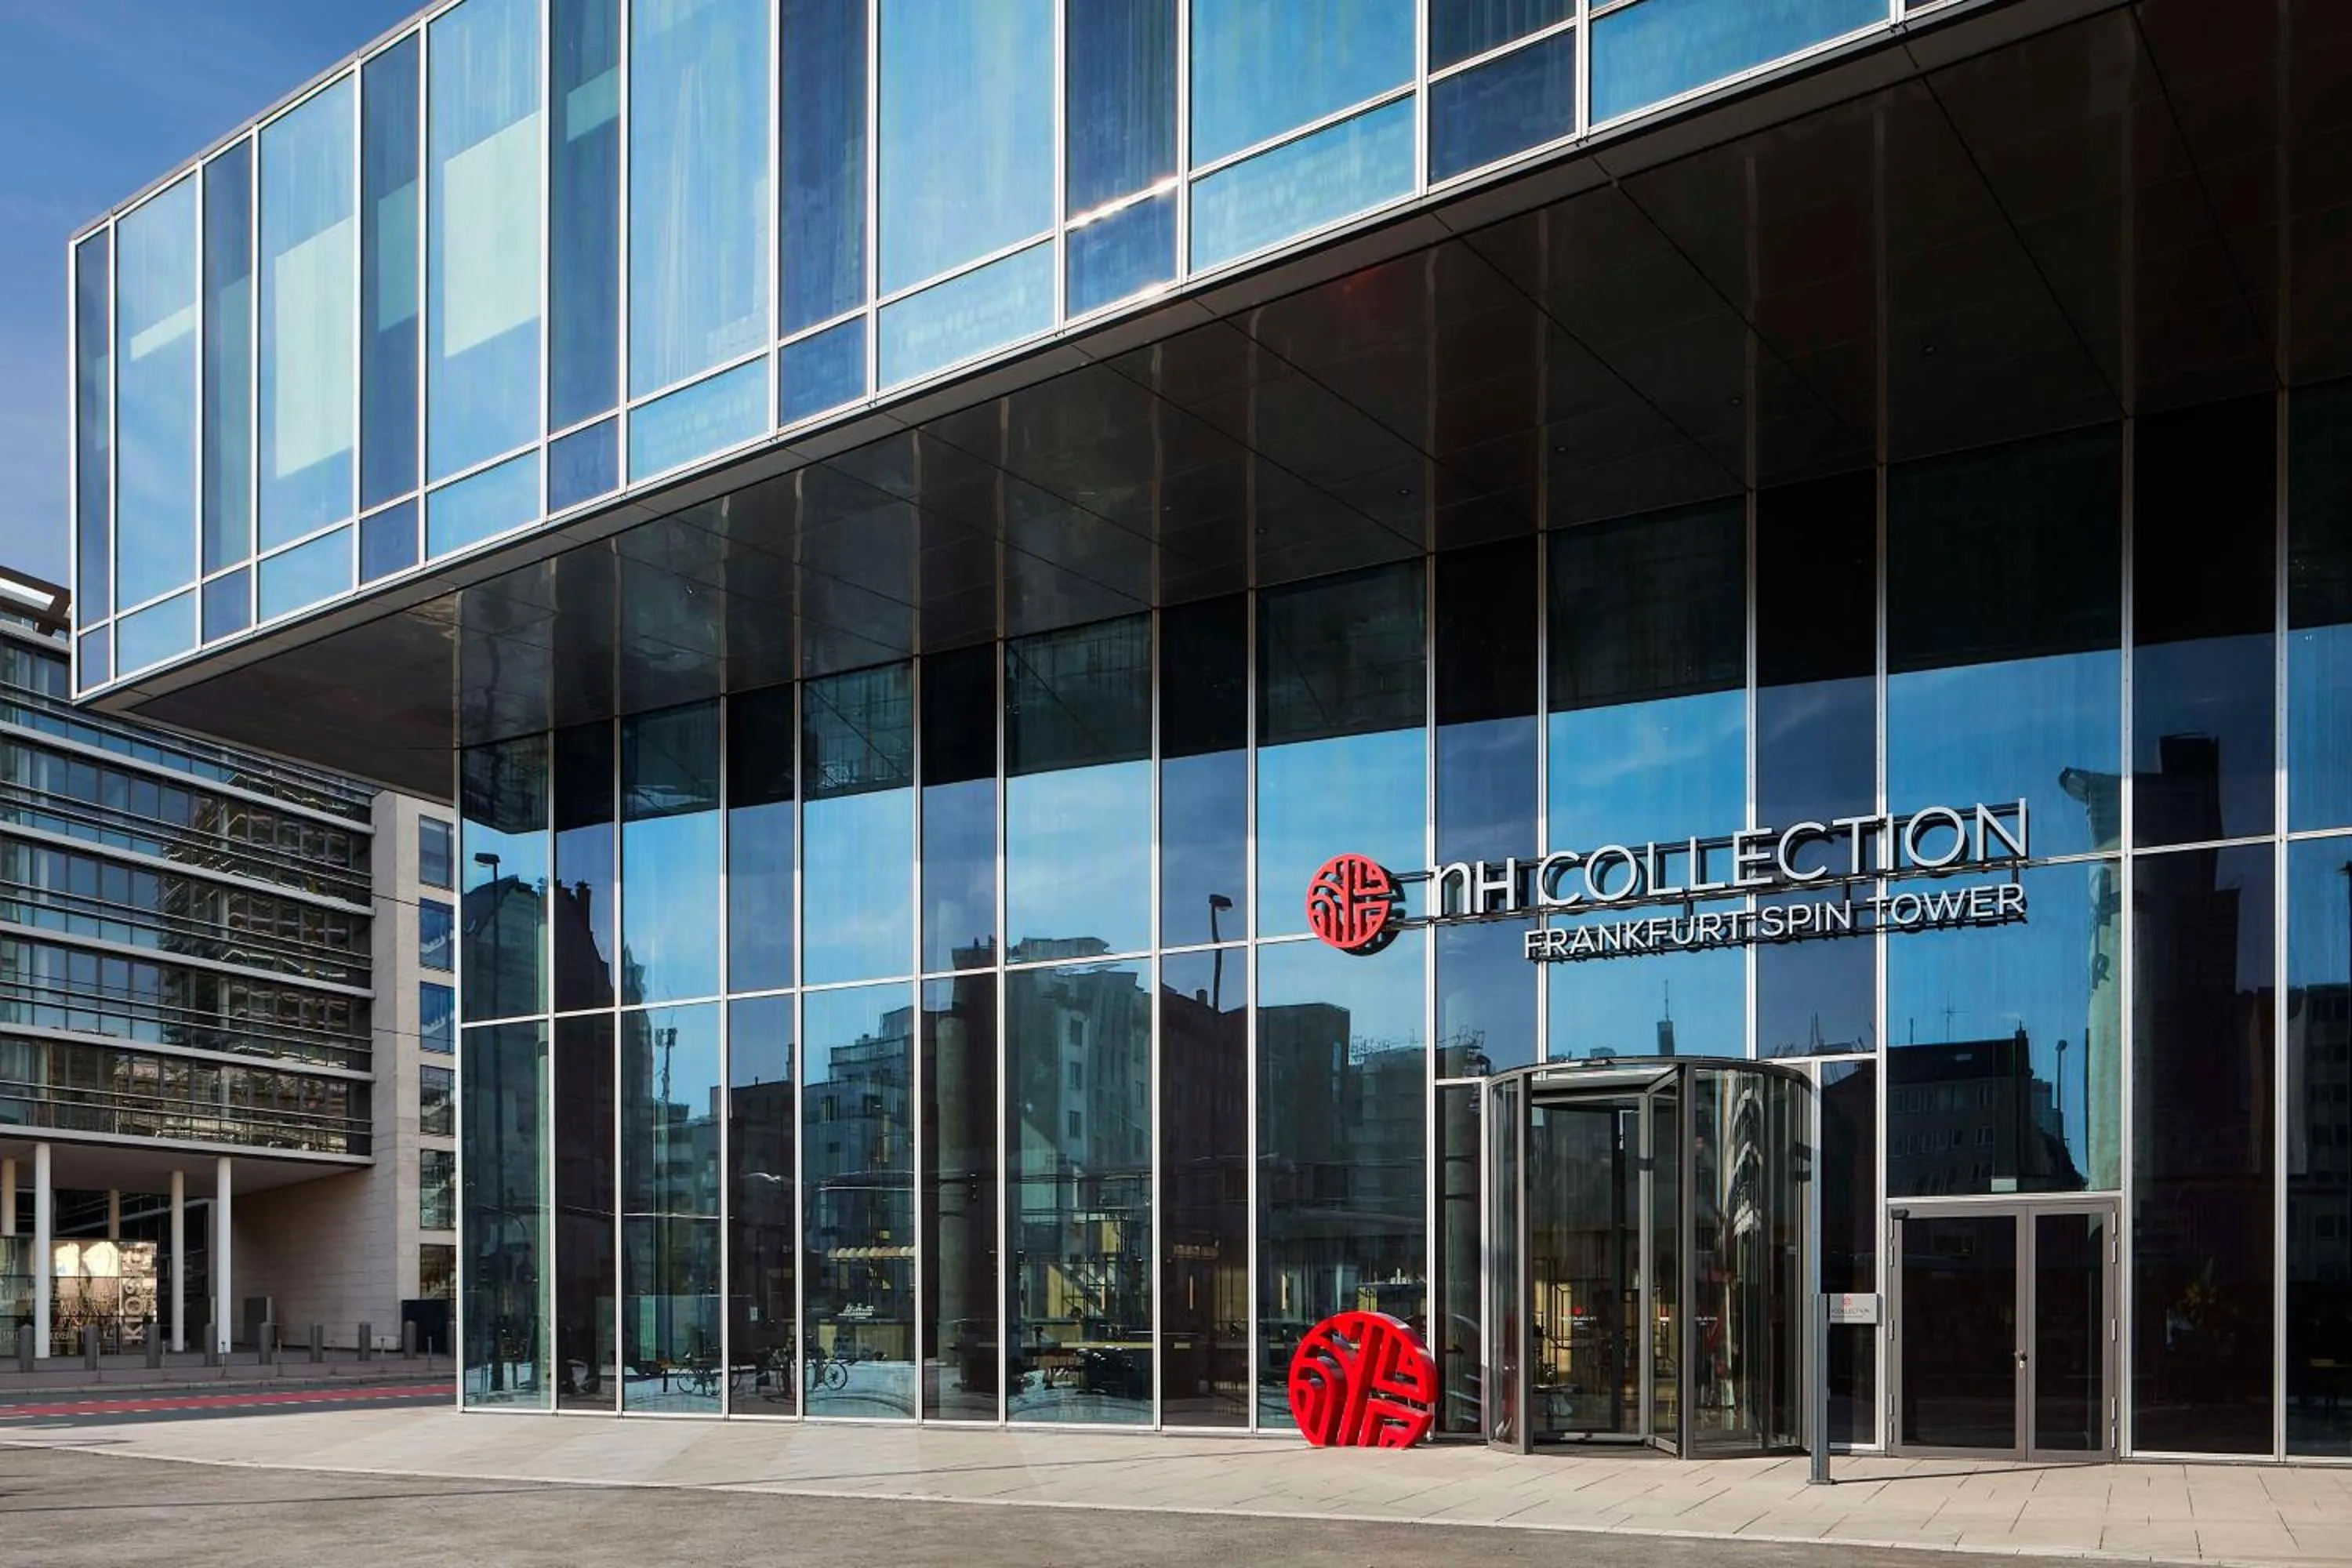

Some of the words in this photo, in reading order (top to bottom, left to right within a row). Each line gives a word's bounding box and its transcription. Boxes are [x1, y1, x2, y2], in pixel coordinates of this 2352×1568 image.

[1537, 797, 2026, 906] COLLECTION
[1524, 910, 1753, 959] FRANKFURT
[1761, 899, 1851, 937] SPIN
[1866, 883, 2025, 925] TOWER
